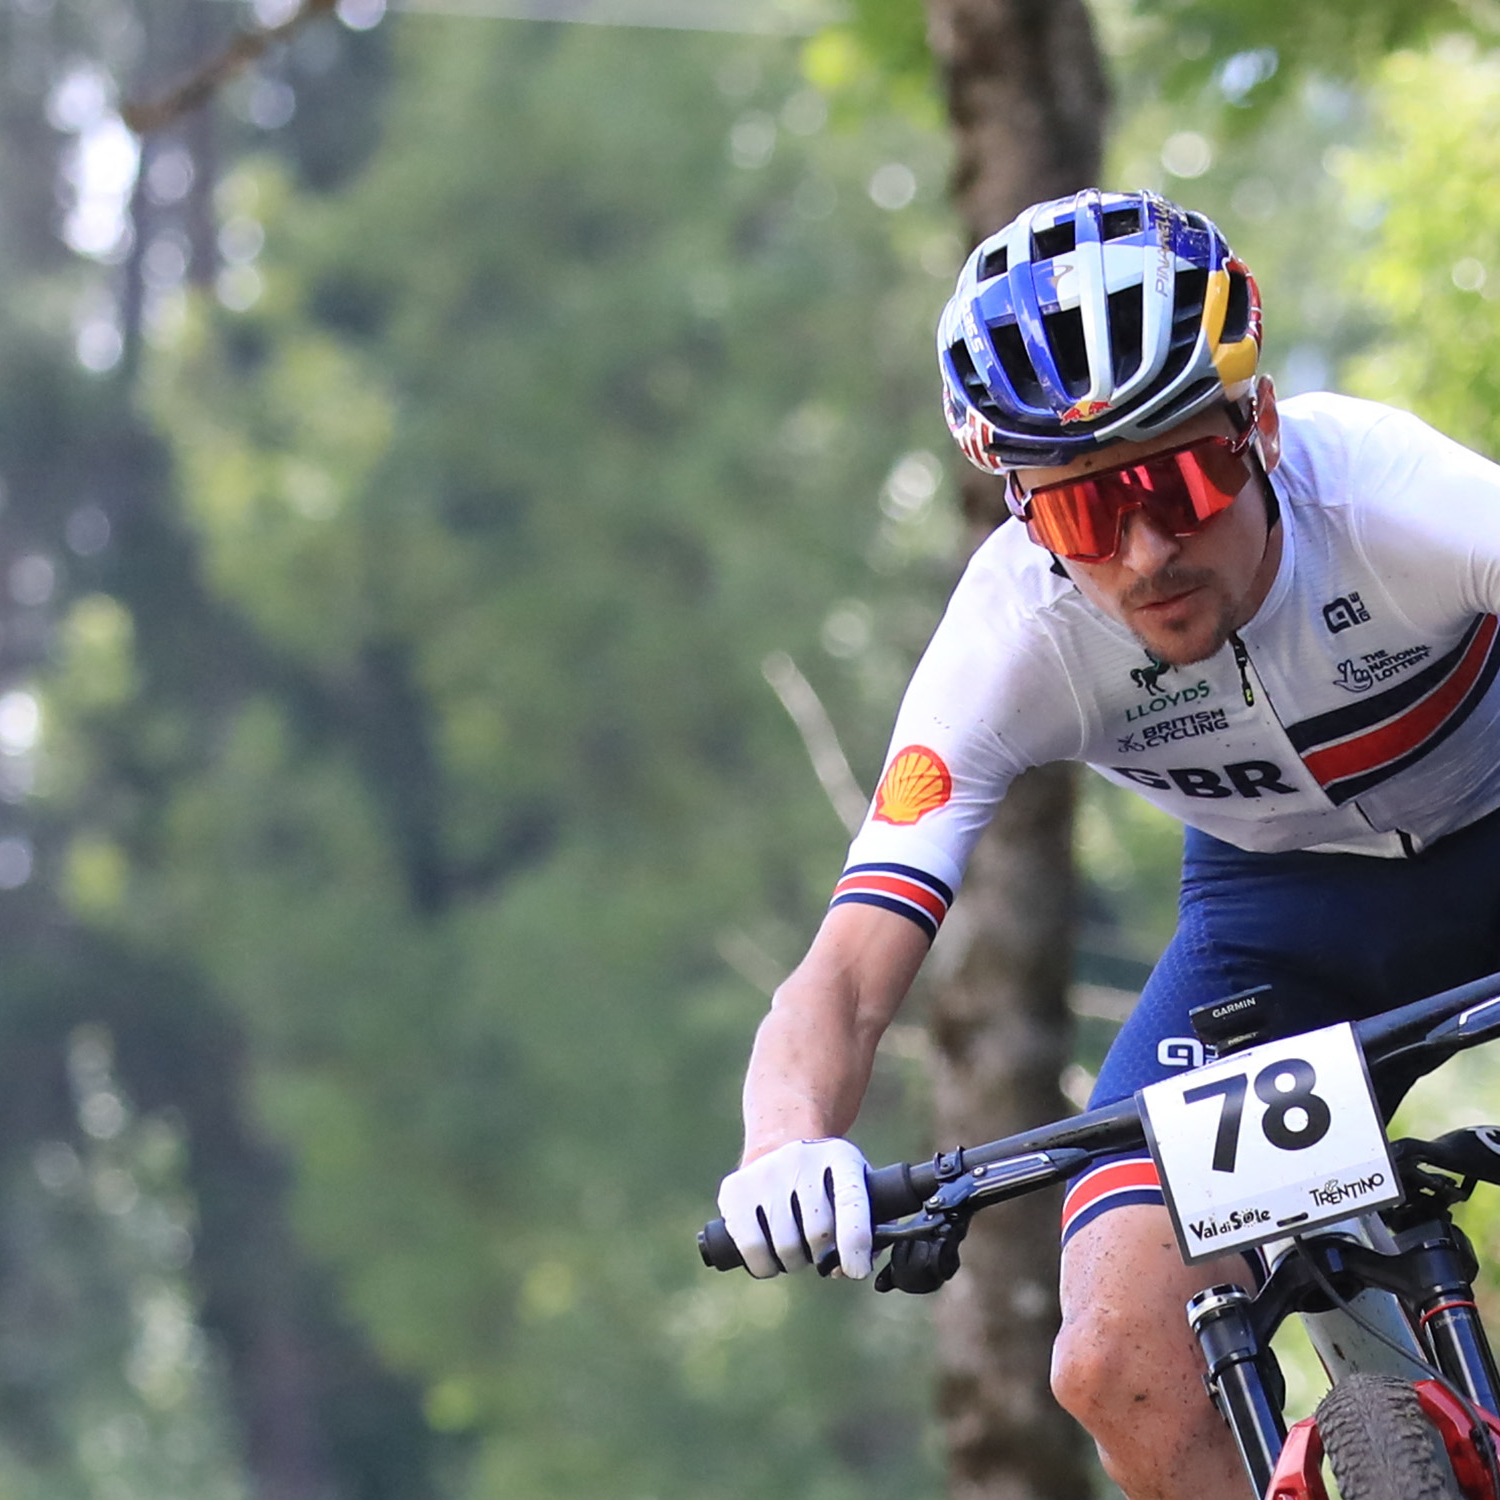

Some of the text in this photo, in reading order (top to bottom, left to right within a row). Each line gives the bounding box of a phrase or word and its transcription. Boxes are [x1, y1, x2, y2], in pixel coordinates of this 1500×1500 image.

[1361, 649, 1389, 663] THE
[1368, 644, 1432, 673] NATIONAL
[1374, 651, 1431, 682] LOTTERY
[1125, 680, 1211, 723] LLOYDS
[1142, 708, 1225, 739] BRITISH
[1146, 719, 1229, 748] CYCLING
[1110, 760, 1300, 798] GBR
[1212, 997, 1256, 1018] GARMIN
[1182, 1058, 1331, 1174] 78
[1309, 1173, 1385, 1207] TRENTINO
[1189, 1209, 1271, 1241] Val di Sole
